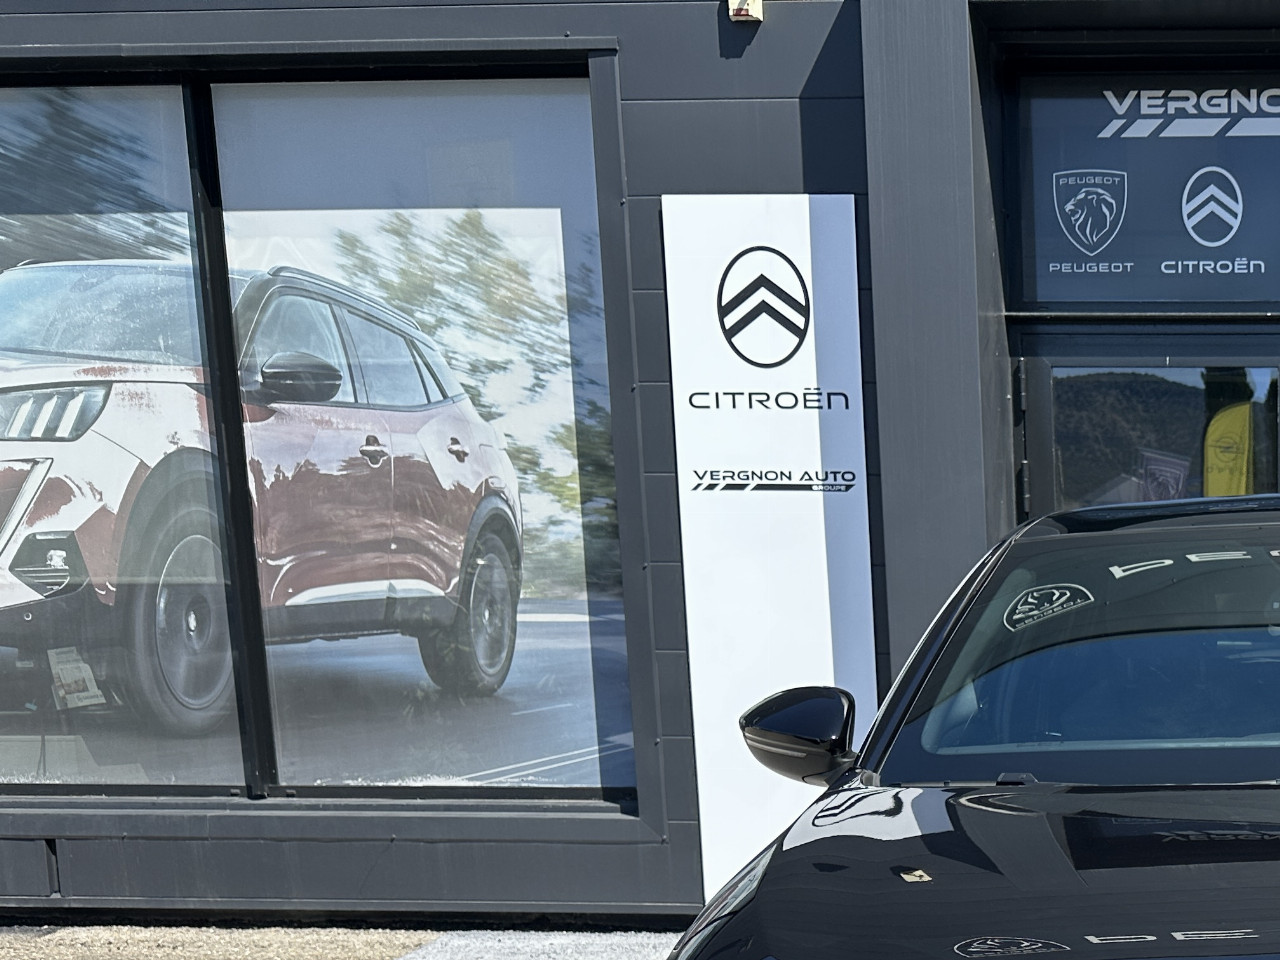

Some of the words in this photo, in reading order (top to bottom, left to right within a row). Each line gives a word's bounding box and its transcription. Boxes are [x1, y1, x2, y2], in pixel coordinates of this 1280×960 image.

[1059, 176, 1121, 186] PEUGEOT
[1050, 263, 1134, 272] PEUGEOT
[694, 471, 791, 481] VERGNON
[800, 471, 856, 482] AUTO
